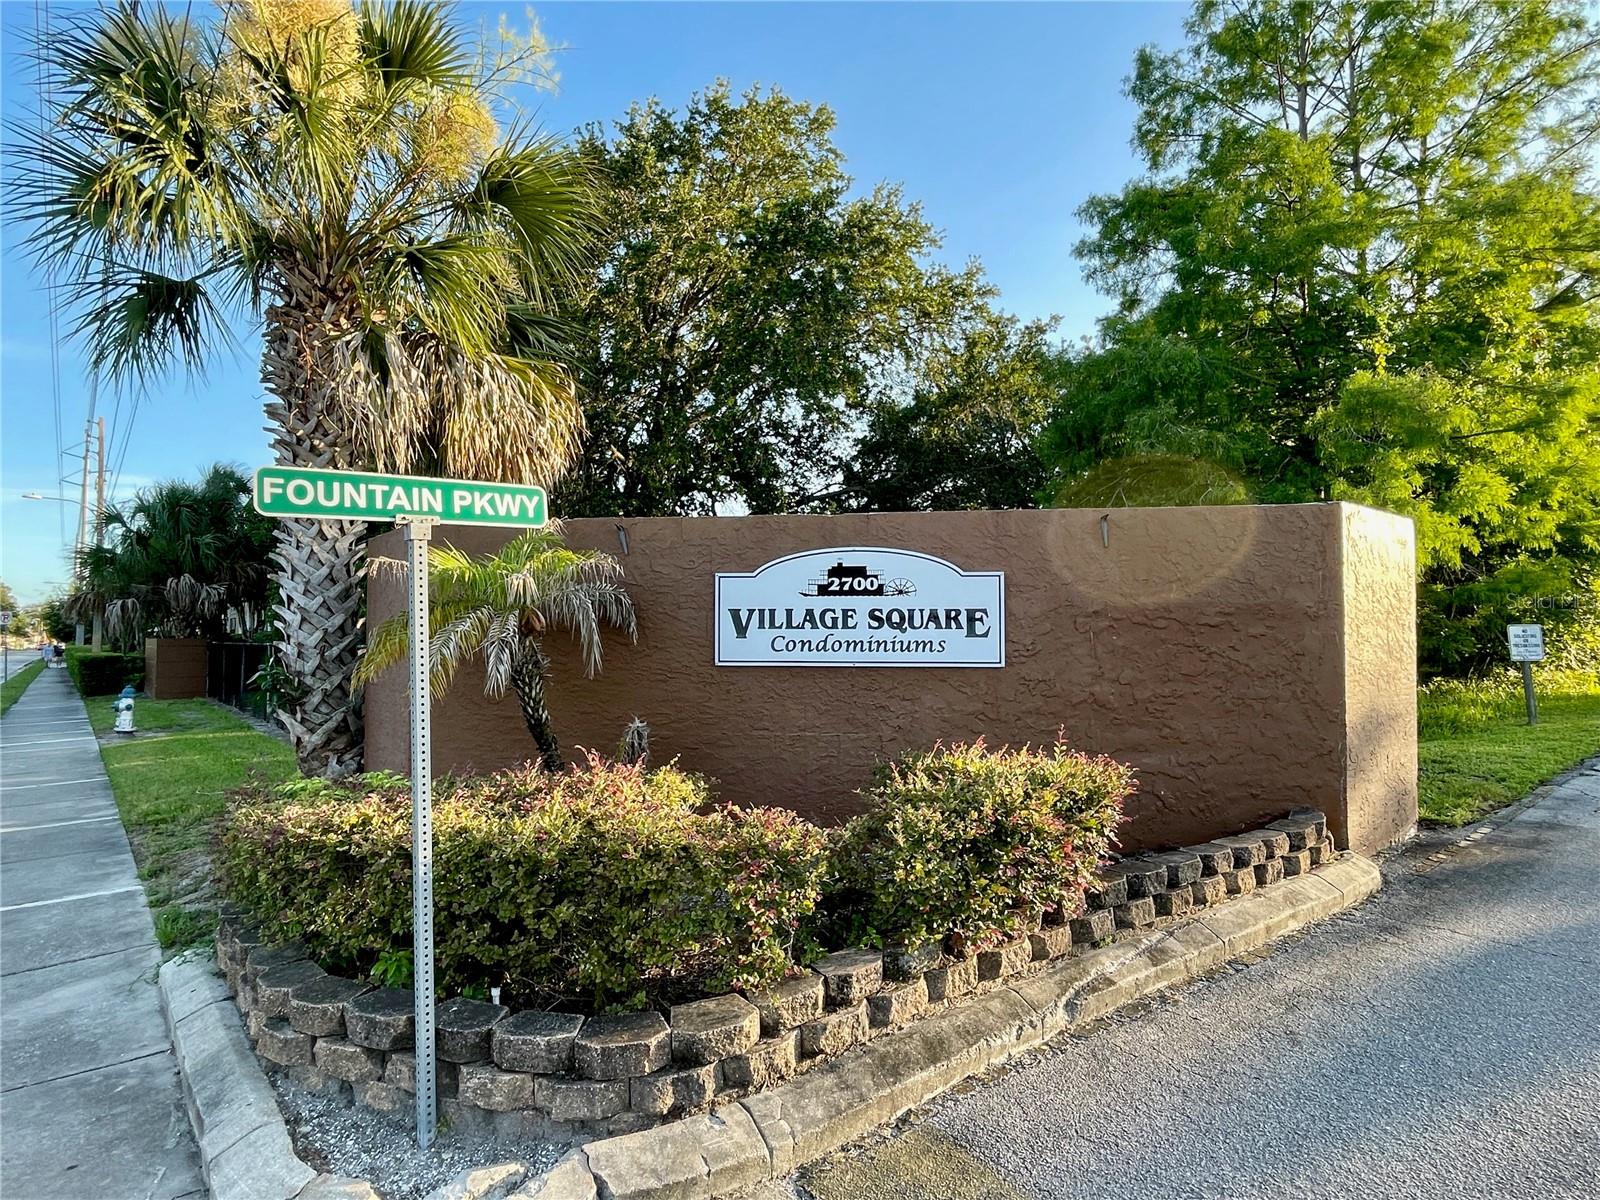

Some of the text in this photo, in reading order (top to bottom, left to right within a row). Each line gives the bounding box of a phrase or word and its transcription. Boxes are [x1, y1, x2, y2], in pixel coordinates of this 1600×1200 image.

[262, 476, 540, 518] FOUNTAIN PKWY
[828, 577, 879, 591] 2700
[728, 608, 991, 638] VILLAGE SQUARE
[770, 633, 946, 653] Condominiums
